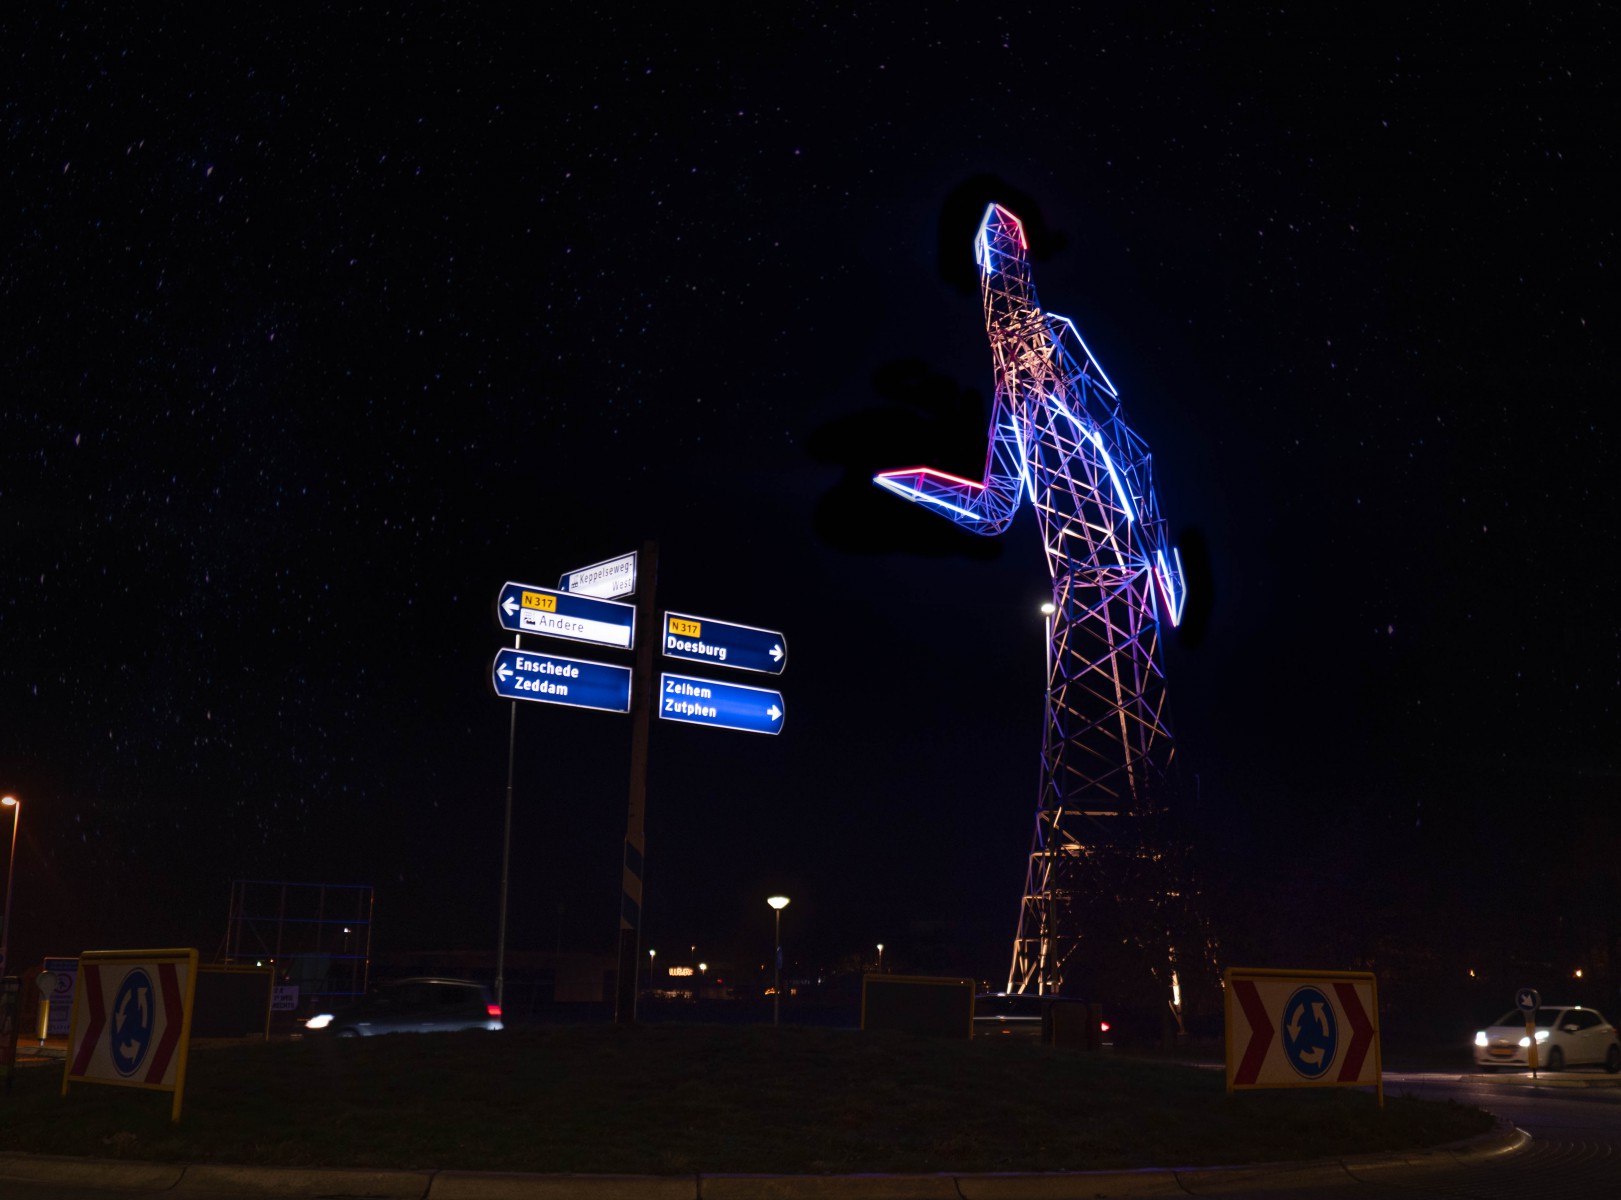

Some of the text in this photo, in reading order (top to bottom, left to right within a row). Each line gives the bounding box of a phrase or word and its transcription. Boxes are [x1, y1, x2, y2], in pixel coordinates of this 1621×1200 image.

[580, 562, 632, 584] Keppelseweg-
[612, 579, 632, 591] West
[525, 596, 553, 608] N 317
[539, 616, 584, 633] Andere
[672, 622, 698, 634] N 317
[668, 636, 726, 660] Doesburg
[516, 657, 580, 678] Enschede
[514, 676, 568, 696] Zeddam
[666, 680, 711, 698] Zelhem
[665, 698, 716, 718] Zutphen
